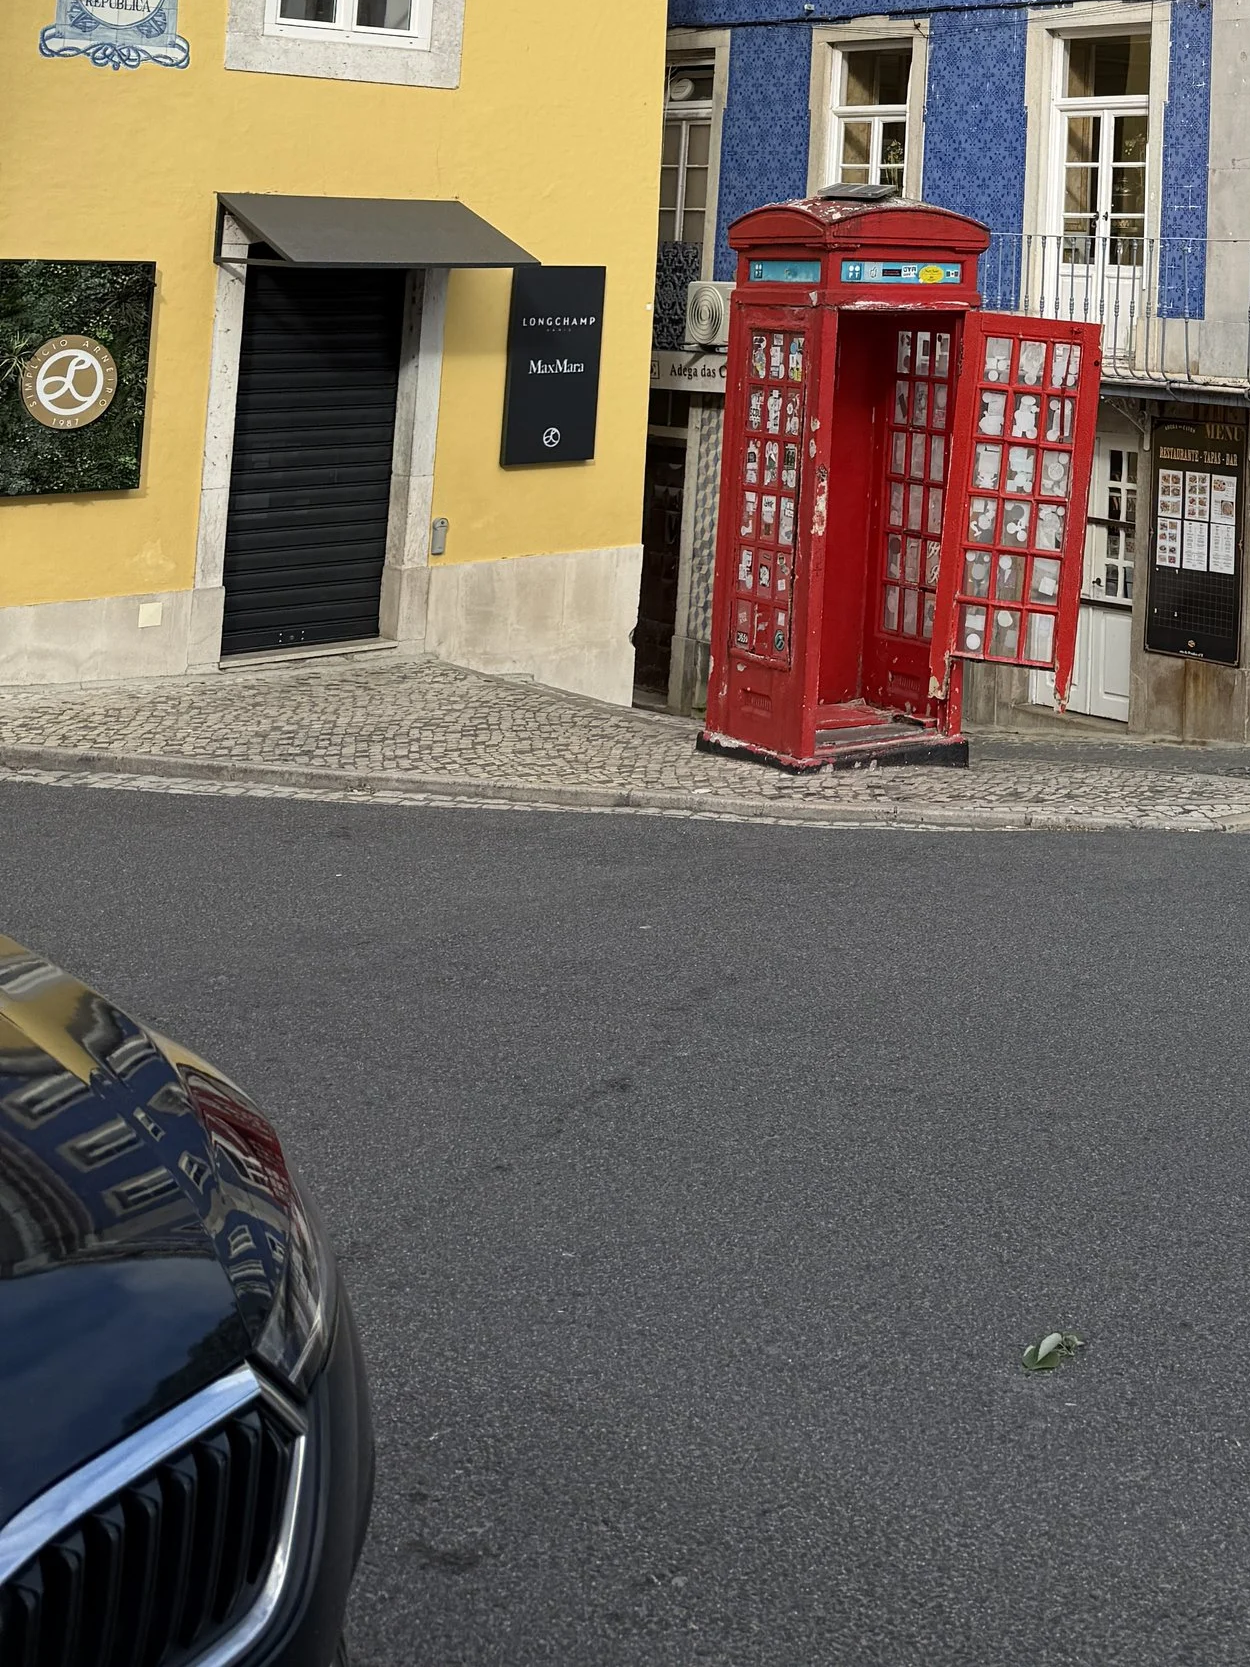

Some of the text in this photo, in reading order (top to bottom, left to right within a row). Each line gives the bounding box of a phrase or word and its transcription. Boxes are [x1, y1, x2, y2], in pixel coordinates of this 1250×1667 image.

[522, 317, 596, 326] LONGCHAMP
[82, 340, 114, 407] ARNEIRO
[528, 359, 584, 374] MaxMara
[670, 363, 698, 380] Adega
[700, 364, 716, 378] das
[52, 418, 79, 426] 1987
[1205, 422, 1243, 441] MENU
[1160, 446, 1238, 466] RESTAURANTE TAPAS BAR
